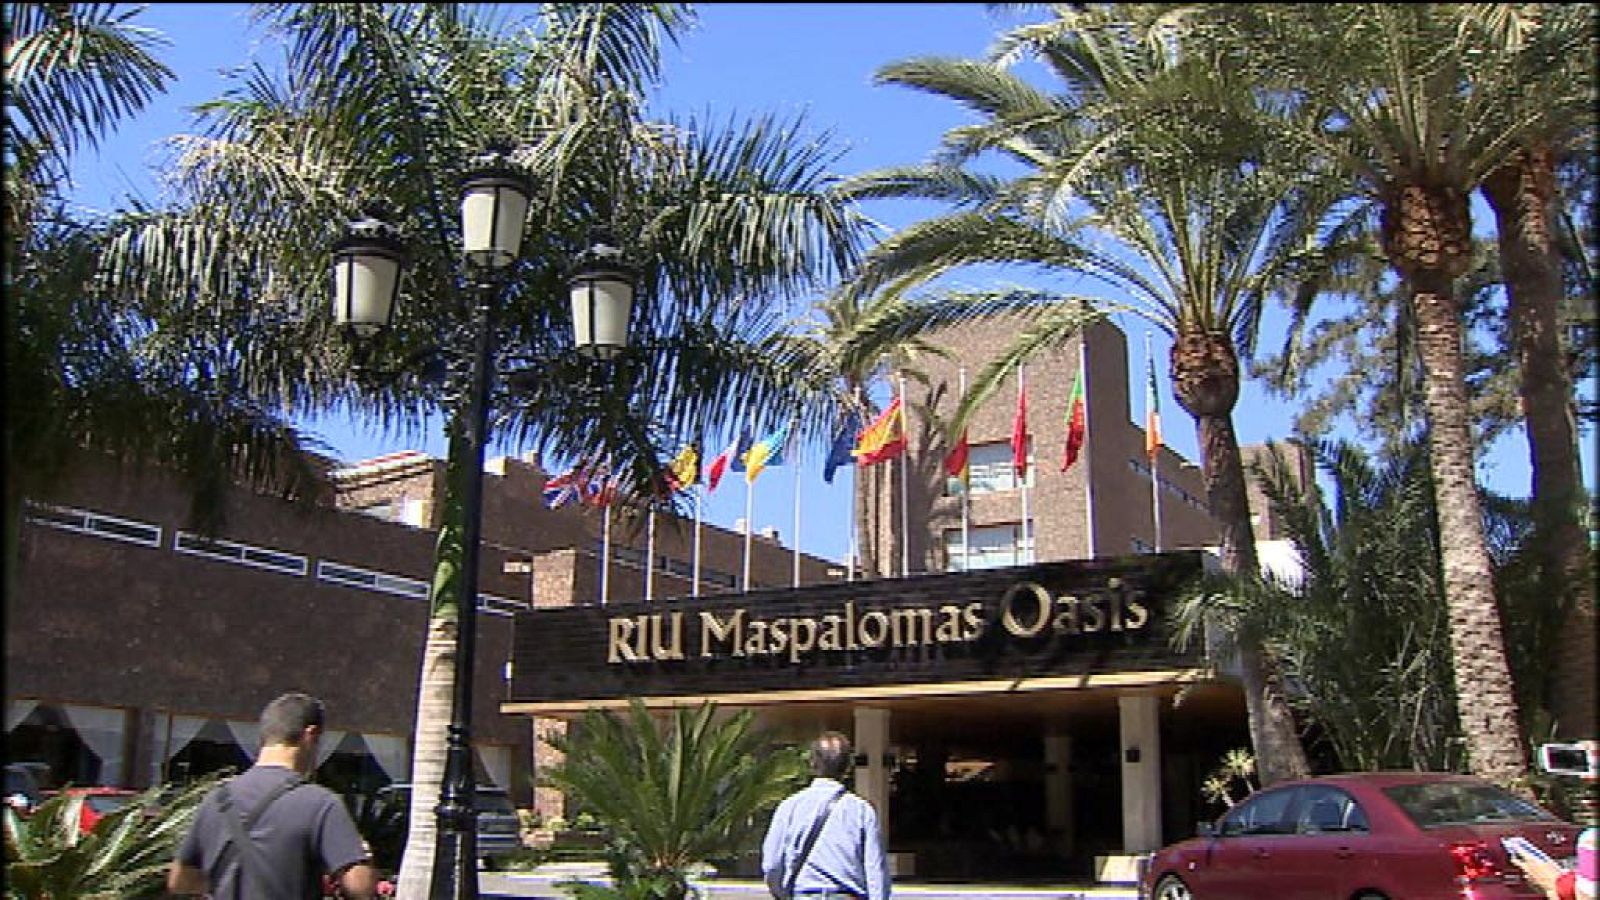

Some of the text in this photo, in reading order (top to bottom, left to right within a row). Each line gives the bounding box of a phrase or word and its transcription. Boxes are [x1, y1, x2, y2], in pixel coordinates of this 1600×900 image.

[607, 577, 1149, 664] RIU Maspalomas Oasis
